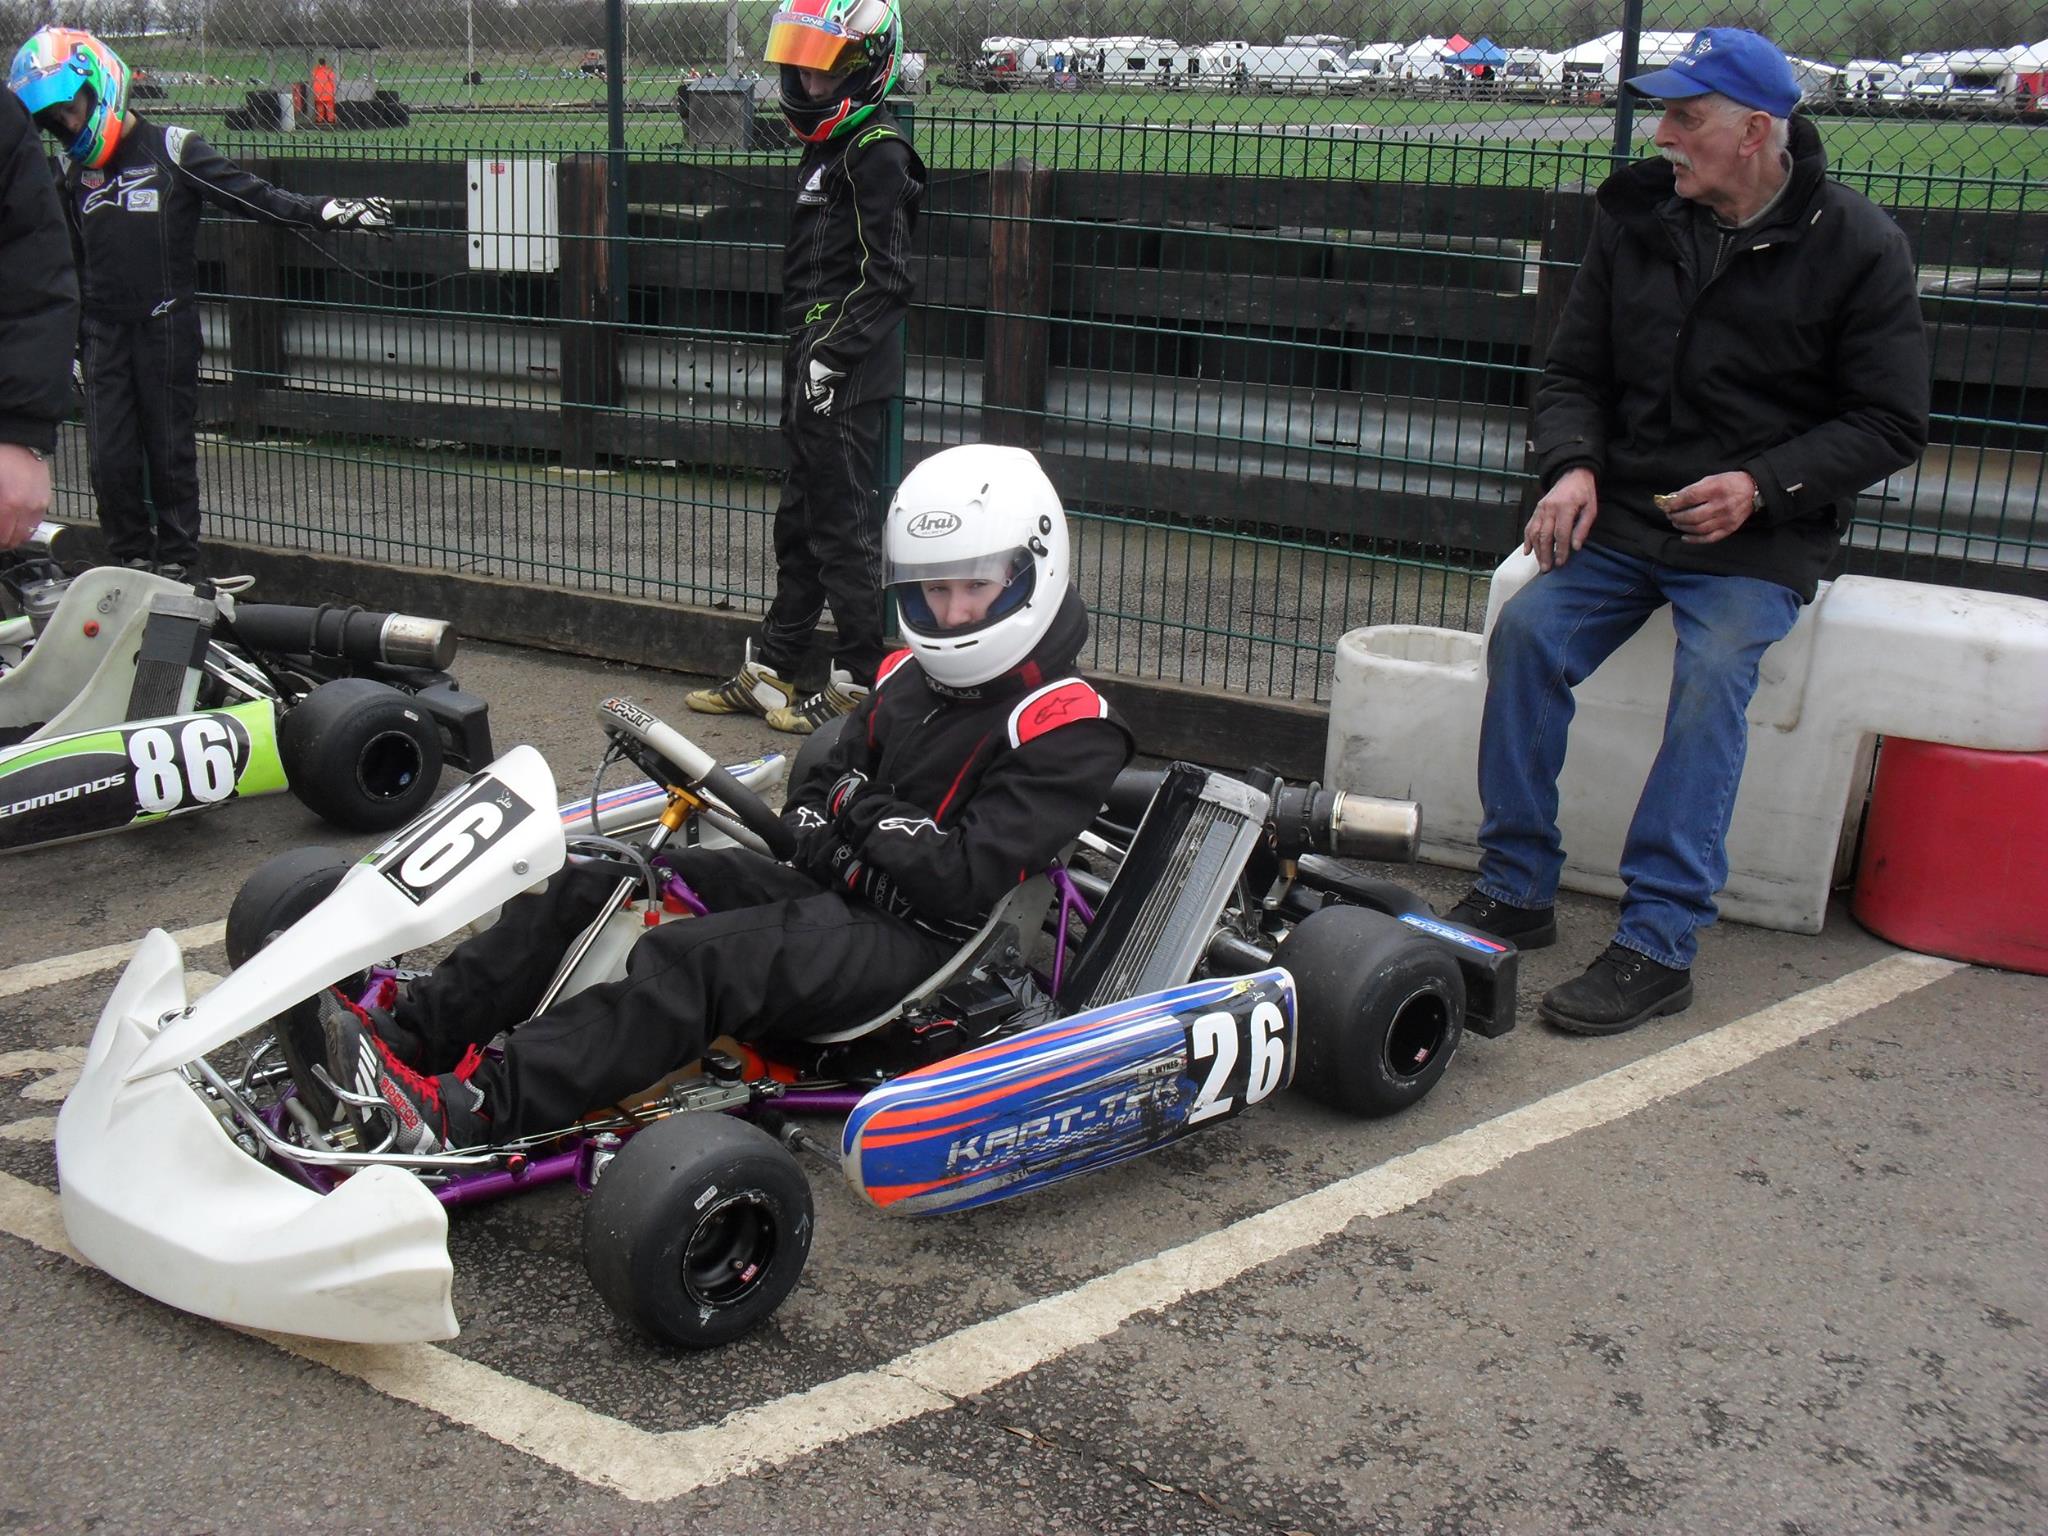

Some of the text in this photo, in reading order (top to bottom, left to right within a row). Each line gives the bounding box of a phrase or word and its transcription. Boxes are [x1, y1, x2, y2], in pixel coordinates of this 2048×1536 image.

[911, 514, 954, 532] Arai
[129, 719, 236, 813] 86
[1155, 1059, 1180, 1074] WYKES
[1188, 1001, 1284, 1125] 26
[380, 1076, 419, 1131] sparco
[947, 1075, 1179, 1168] KART-TEK
